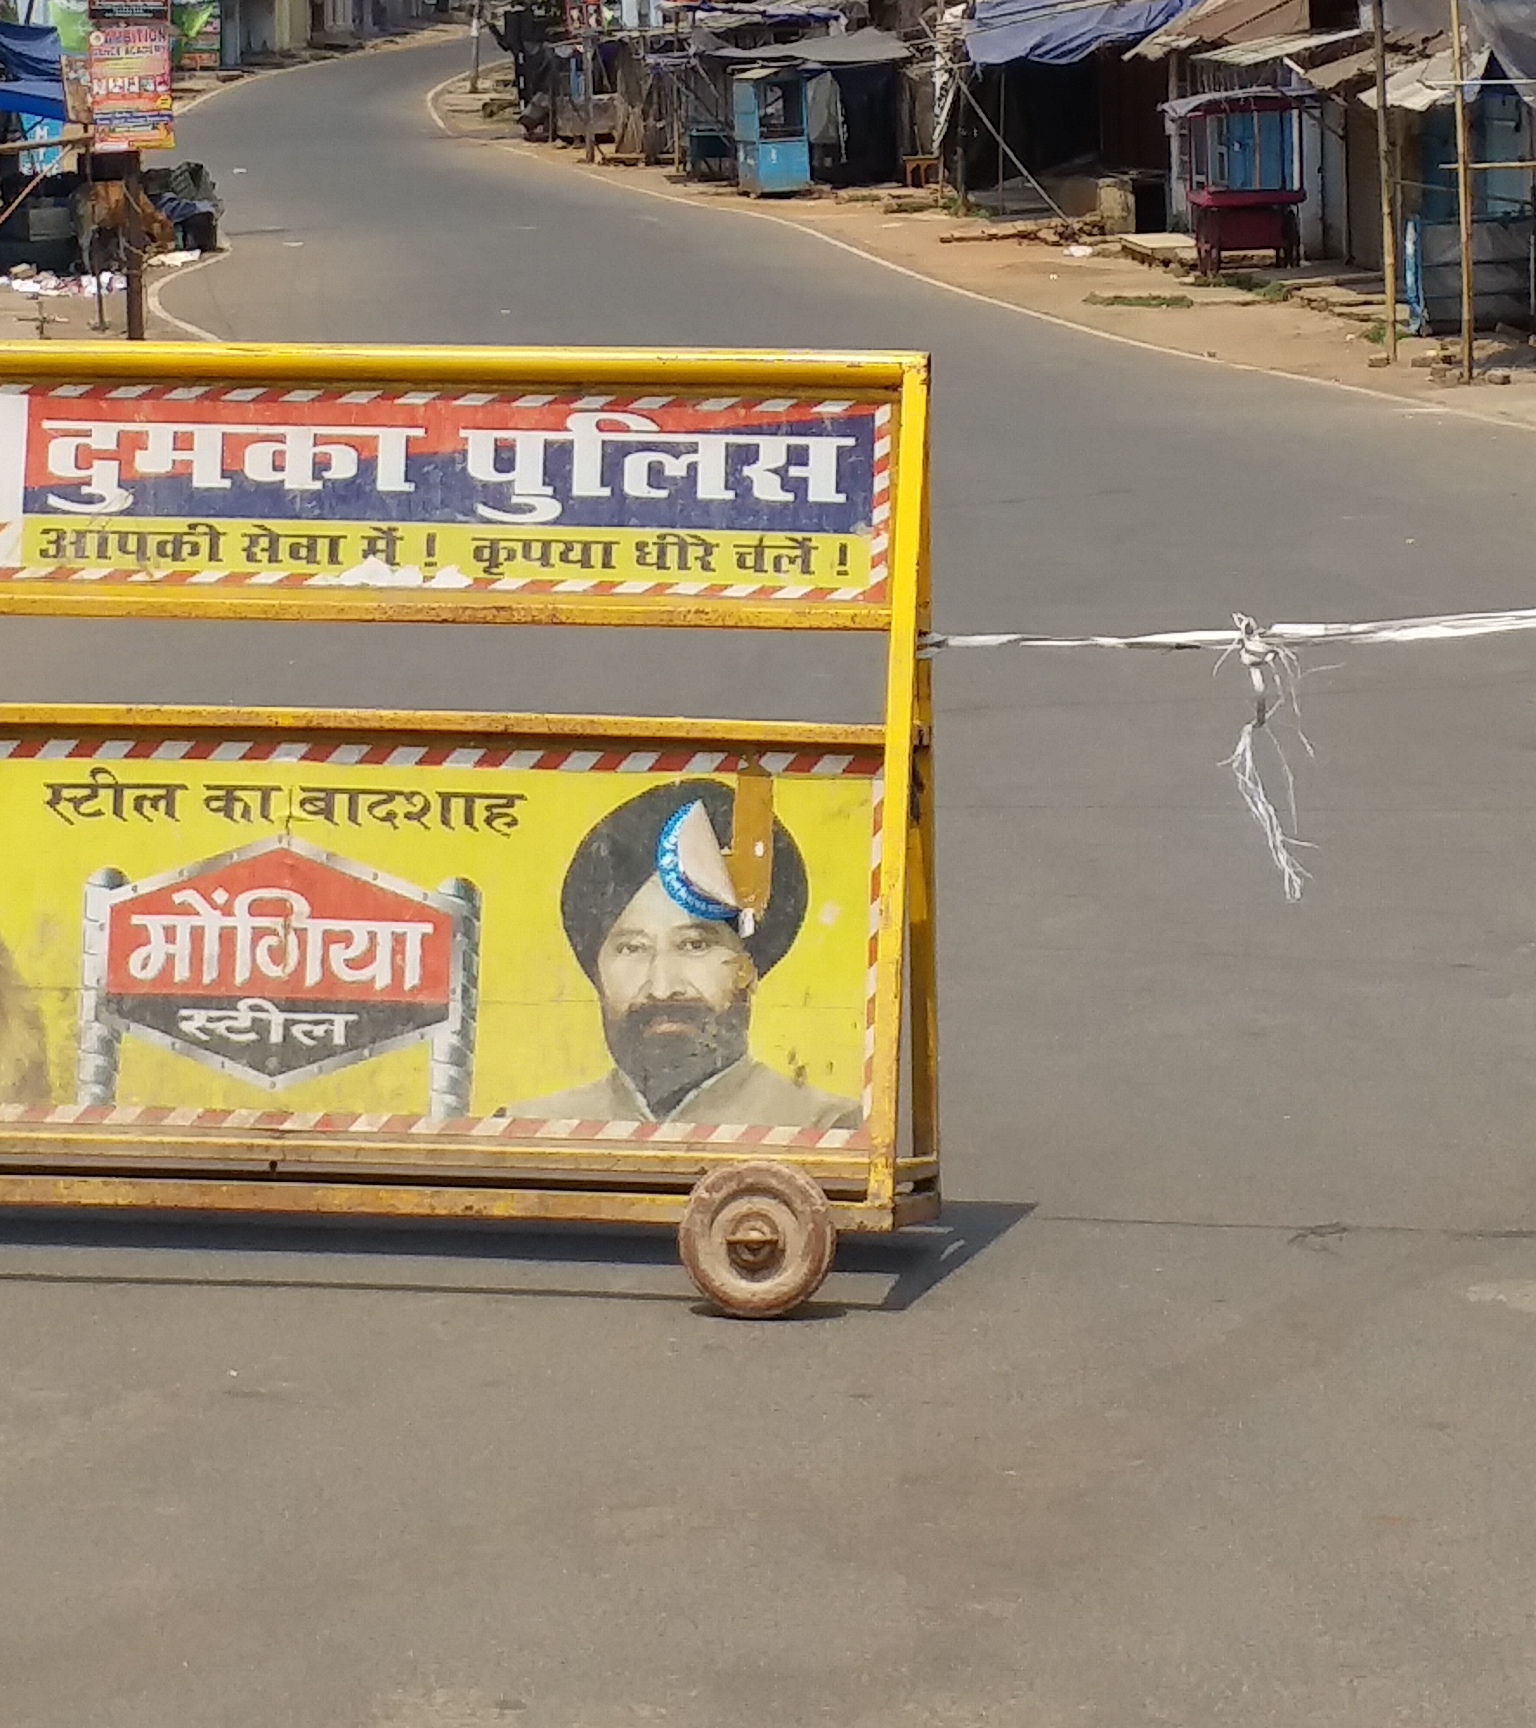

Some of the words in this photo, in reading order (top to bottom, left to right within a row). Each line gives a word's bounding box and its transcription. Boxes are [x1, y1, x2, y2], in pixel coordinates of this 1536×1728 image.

[41, 418, 427, 514] दुमका
[459, 409, 858, 524] पुलिस
[39, 520, 227, 567] आपकी
[241, 524, 348, 567] सेवा
[361, 527, 404, 568] में
[425, 532, 438, 568] !
[470, 535, 620, 576] कृपया
[635, 533, 721, 573] धीरे
[734, 534, 819, 576] चलें
[836, 541, 850, 576] !
[44, 768, 184, 825] स्टील
[204, 784, 287, 821] का
[296, 788, 528, 838] बादशाह
[127, 889, 435, 994] मोंगिया
[176, 999, 357, 1048] स्टील
